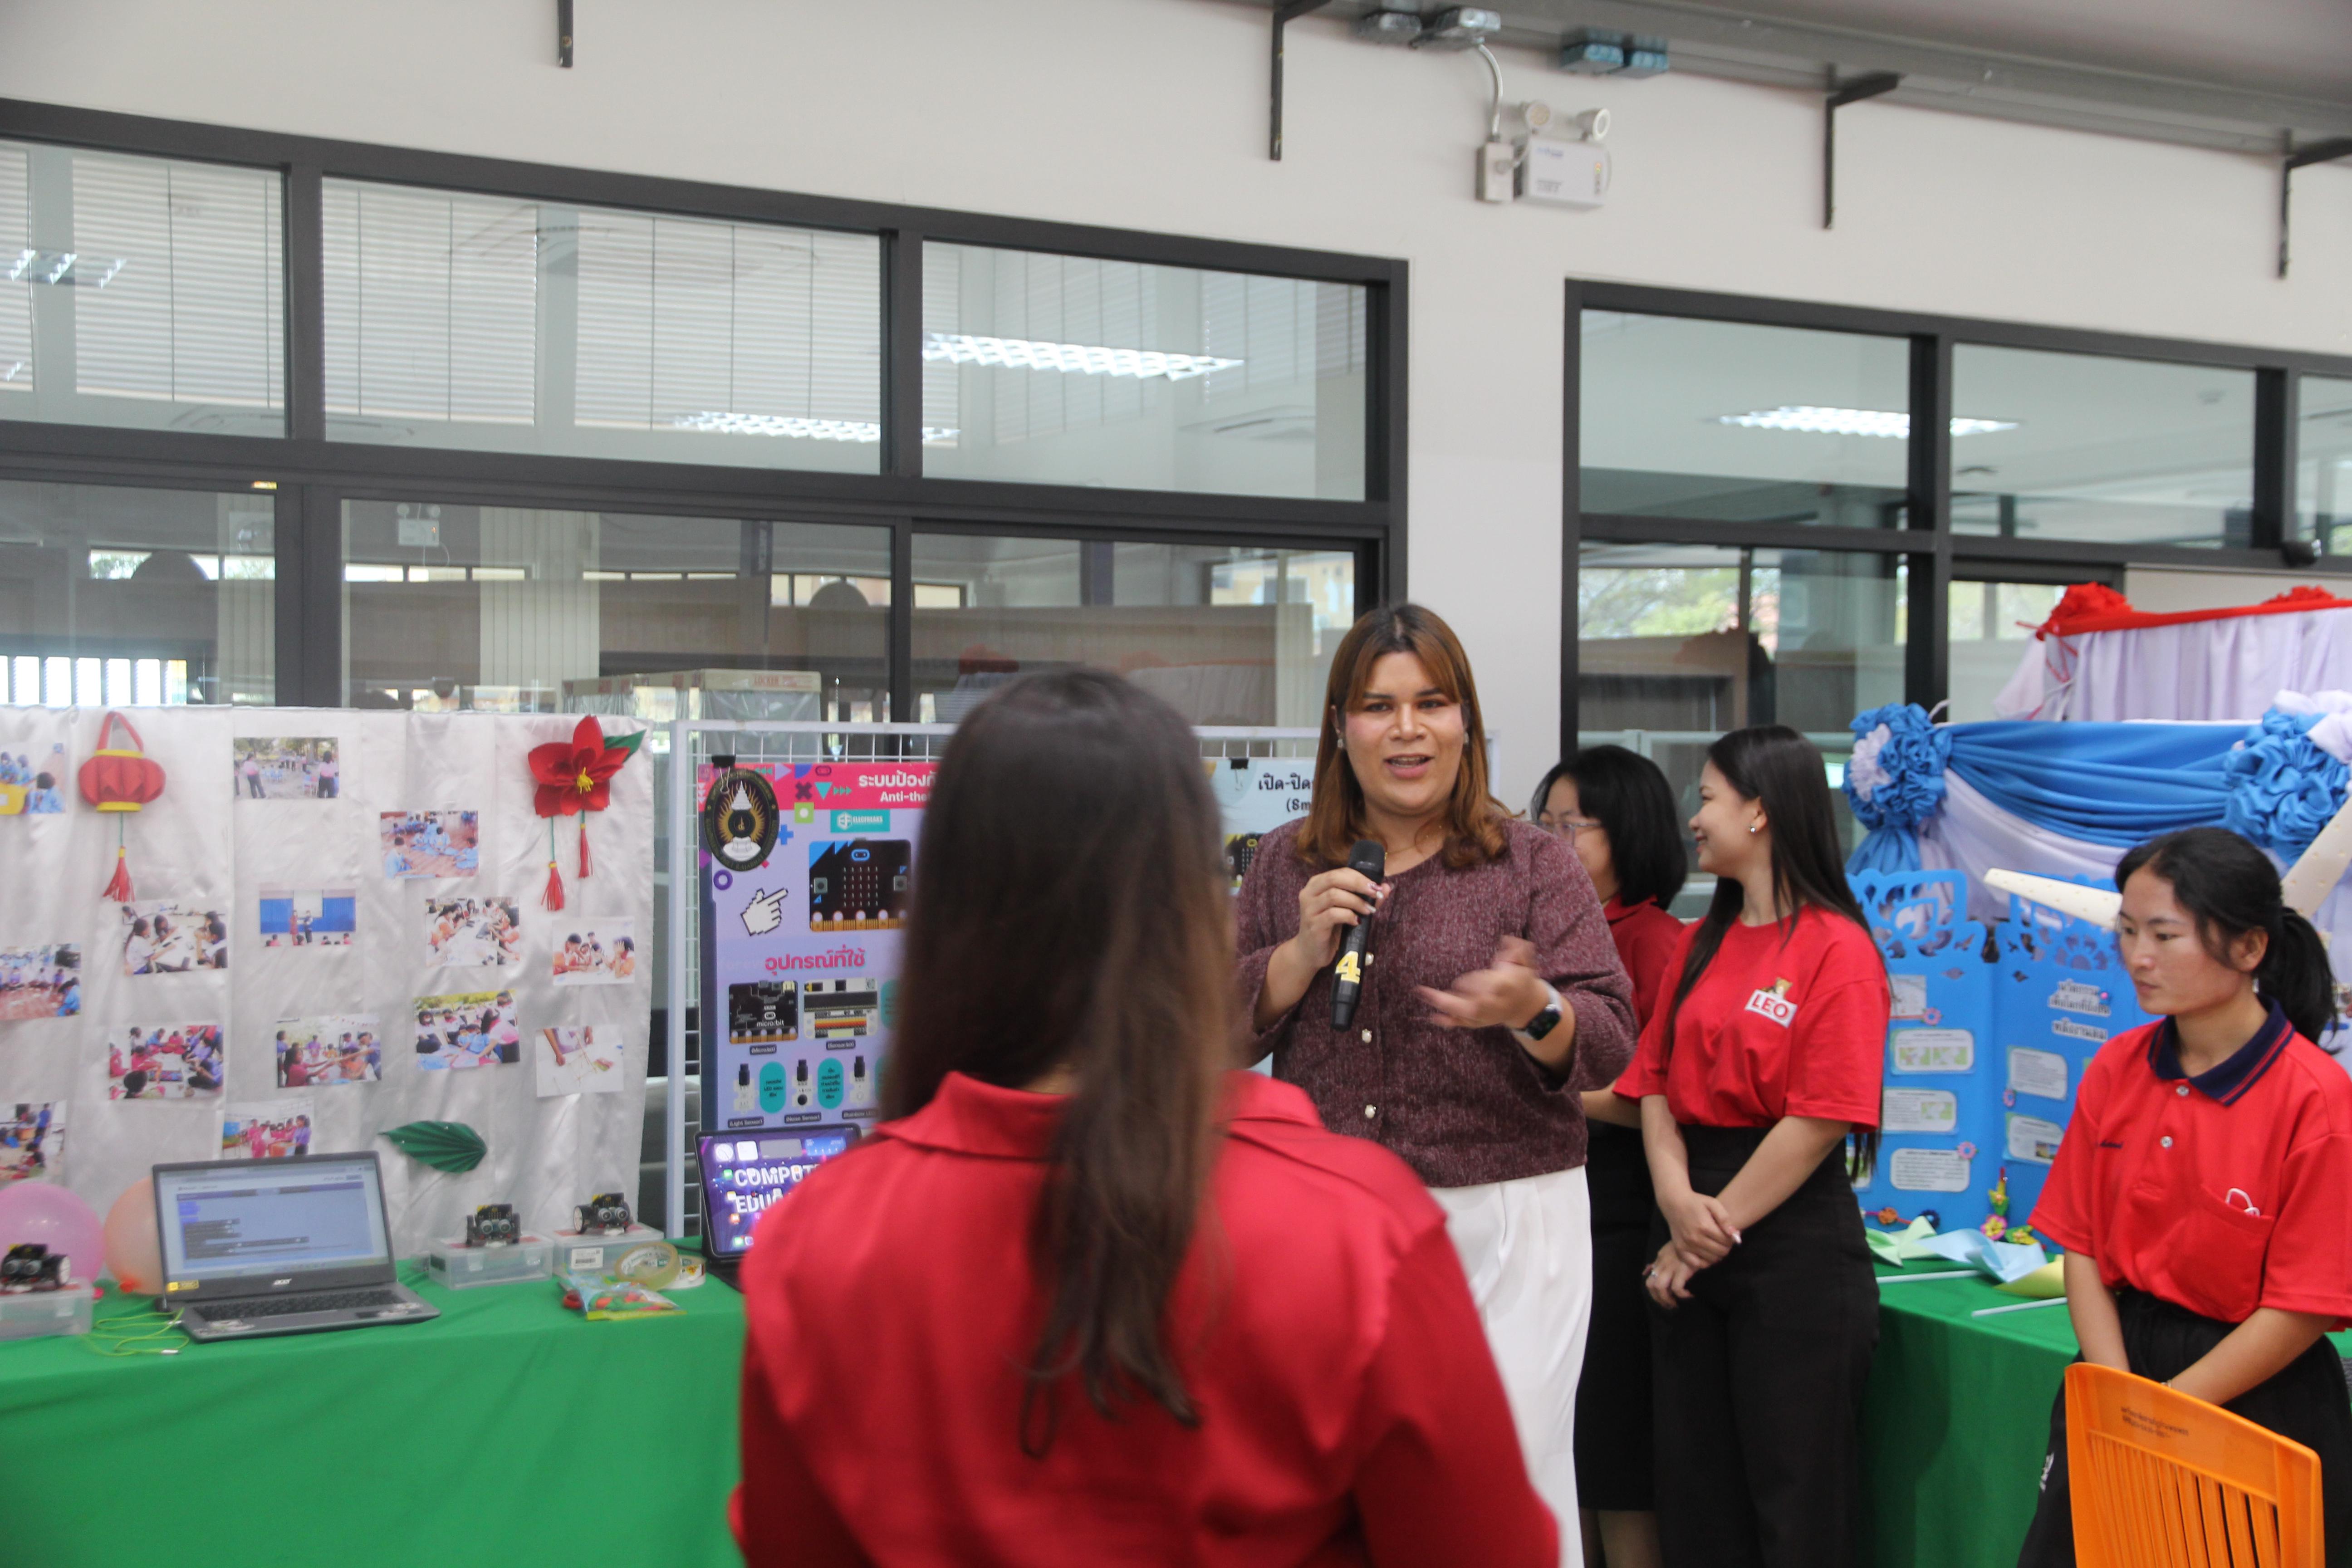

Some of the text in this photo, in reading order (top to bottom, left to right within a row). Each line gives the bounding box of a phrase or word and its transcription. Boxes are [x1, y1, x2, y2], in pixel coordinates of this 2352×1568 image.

[858, 769, 936, 787] ระบบป้องกั
[1259, 772, 1312, 790] เปิด-ปิด
[880, 790, 928, 803] Anti-the
[1286, 799, 1310, 812] (Sm
[765, 944, 866, 976] อุปกรณ์ที่ใช้
[1335, 950, 1361, 985] 4
[1752, 994, 1789, 1018] LEO
